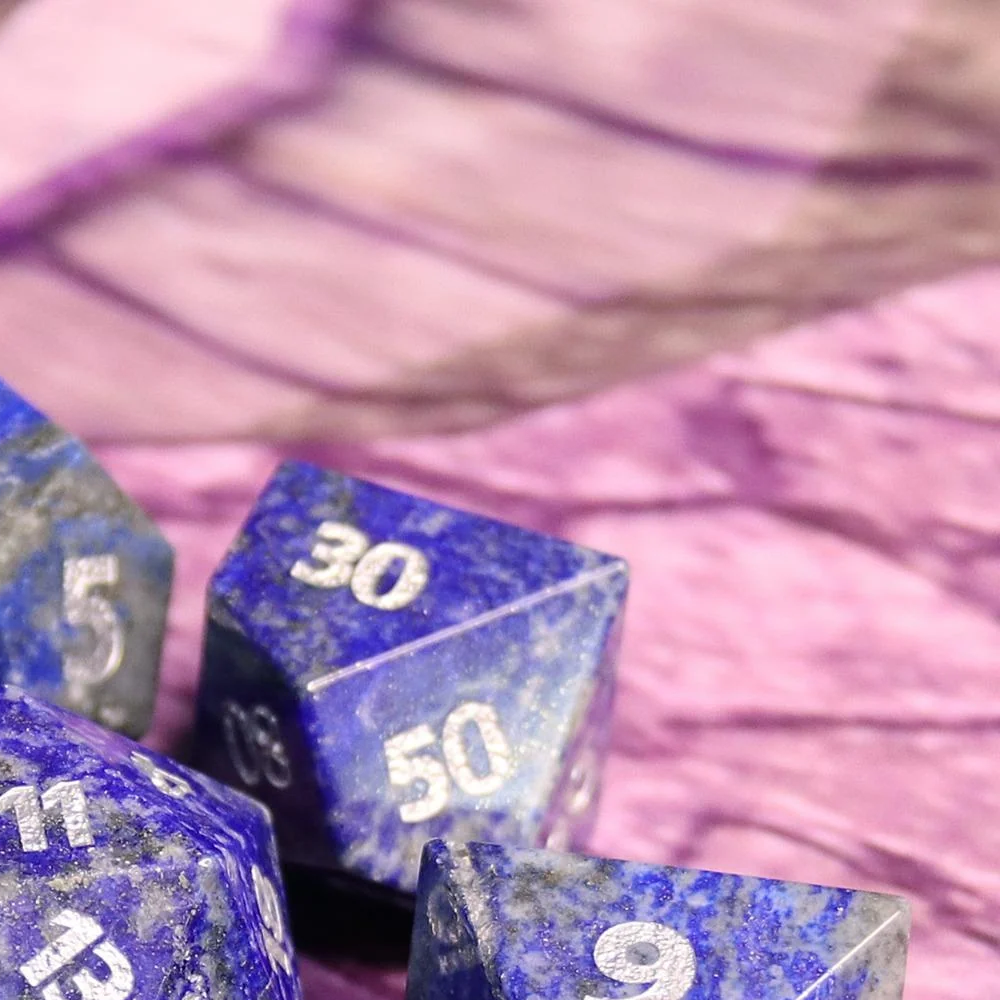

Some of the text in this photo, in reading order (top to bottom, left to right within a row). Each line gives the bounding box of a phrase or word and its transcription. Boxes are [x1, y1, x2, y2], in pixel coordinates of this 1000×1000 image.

[63, 554, 124, 684] 5
[290, 521, 430, 611] 30
[384, 702, 518, 823] 50
